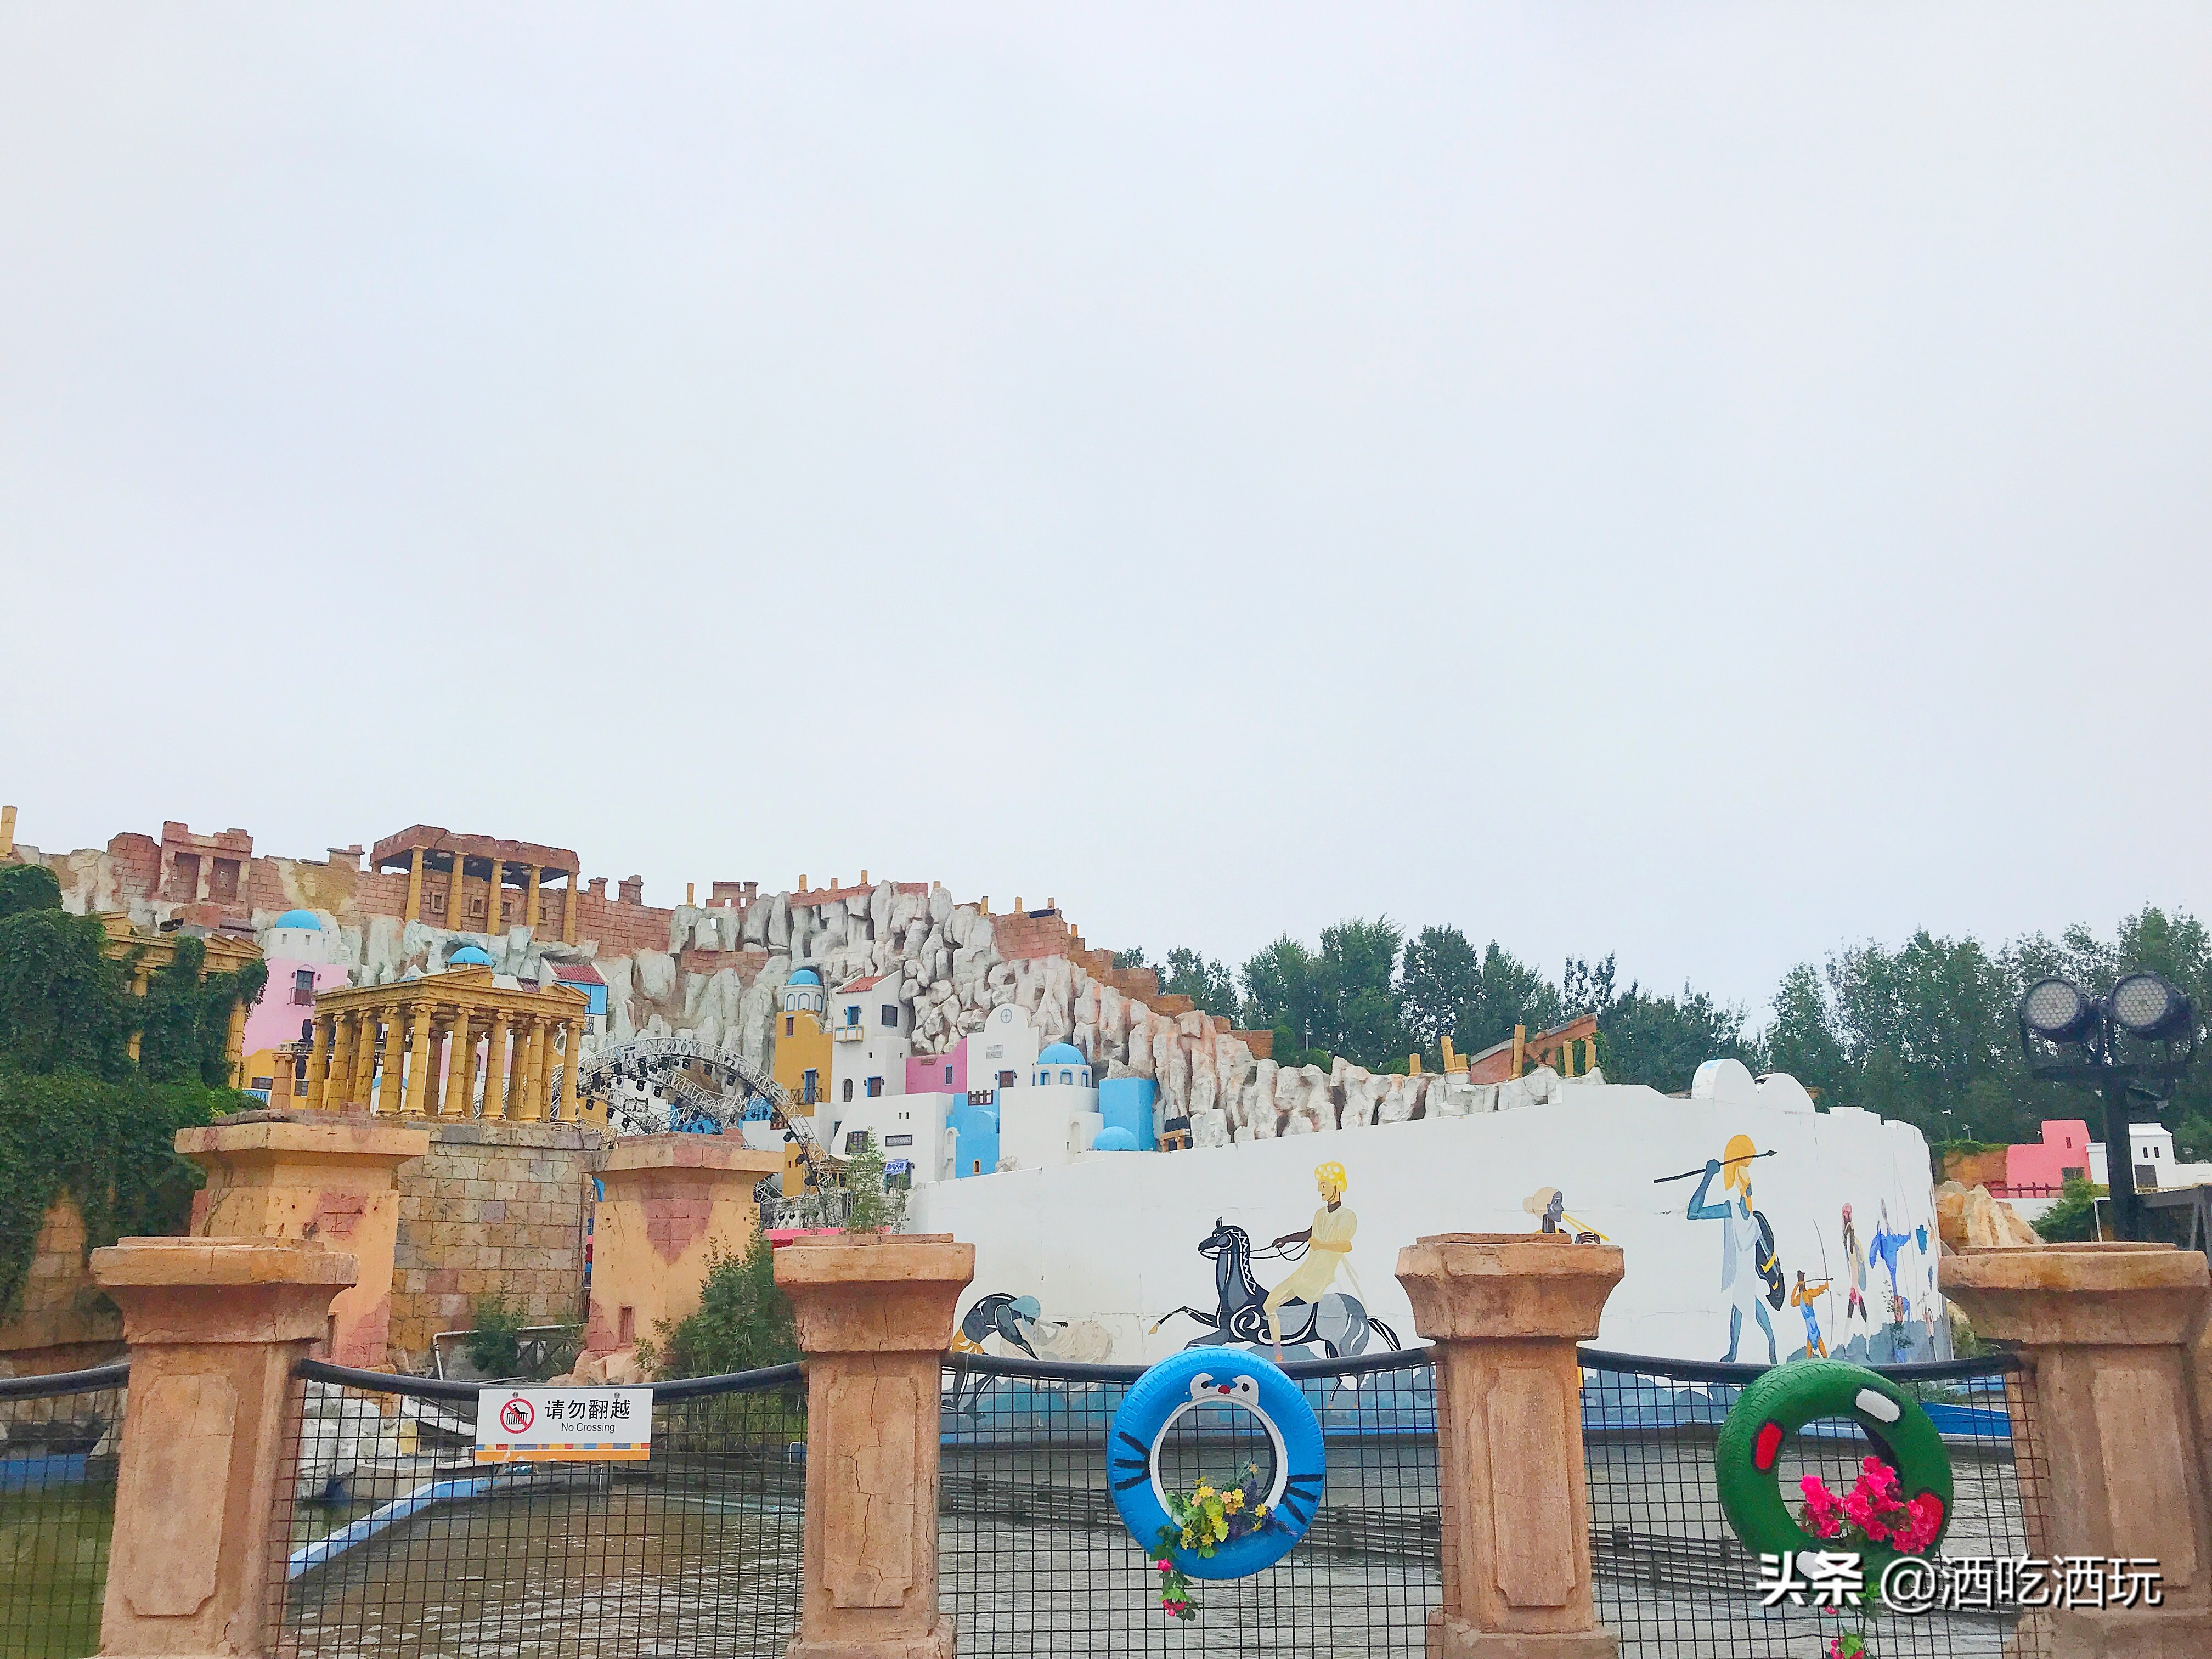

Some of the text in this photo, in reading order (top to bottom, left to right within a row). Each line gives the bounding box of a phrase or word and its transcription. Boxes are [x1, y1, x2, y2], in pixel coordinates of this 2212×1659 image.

[544, 1398, 630, 1420] 请勿翻越
[561, 1423, 615, 1434] No Crossing
